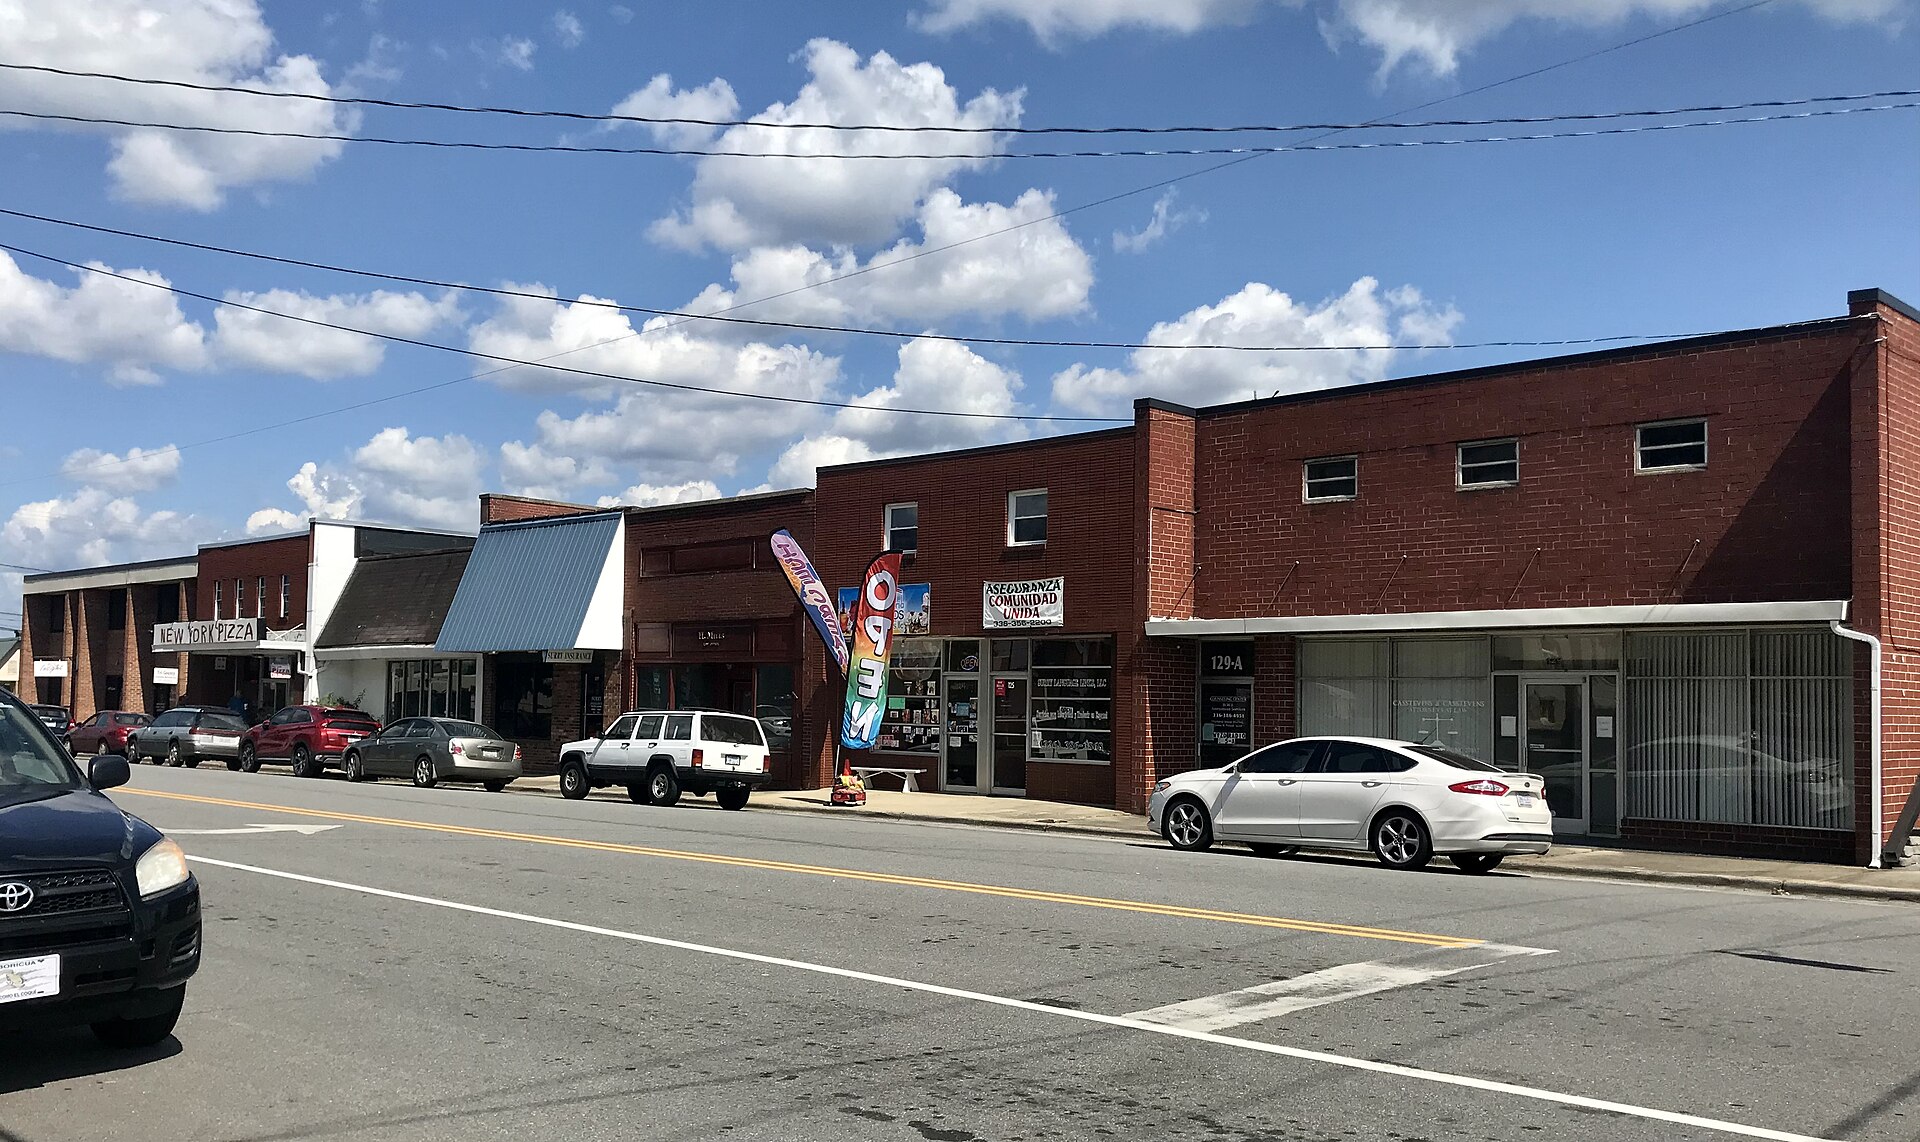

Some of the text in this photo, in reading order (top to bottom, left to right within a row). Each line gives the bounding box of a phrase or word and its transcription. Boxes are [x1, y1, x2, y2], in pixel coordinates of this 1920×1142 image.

[985, 579, 1062, 595] ASEGURANZA
[988, 592, 1058, 608] COMUNIDAD
[1003, 606, 1041, 620] UNIDA
[160, 622, 254, 644] NEW YORK PIZZA
[960, 658, 979, 669] OPEN
